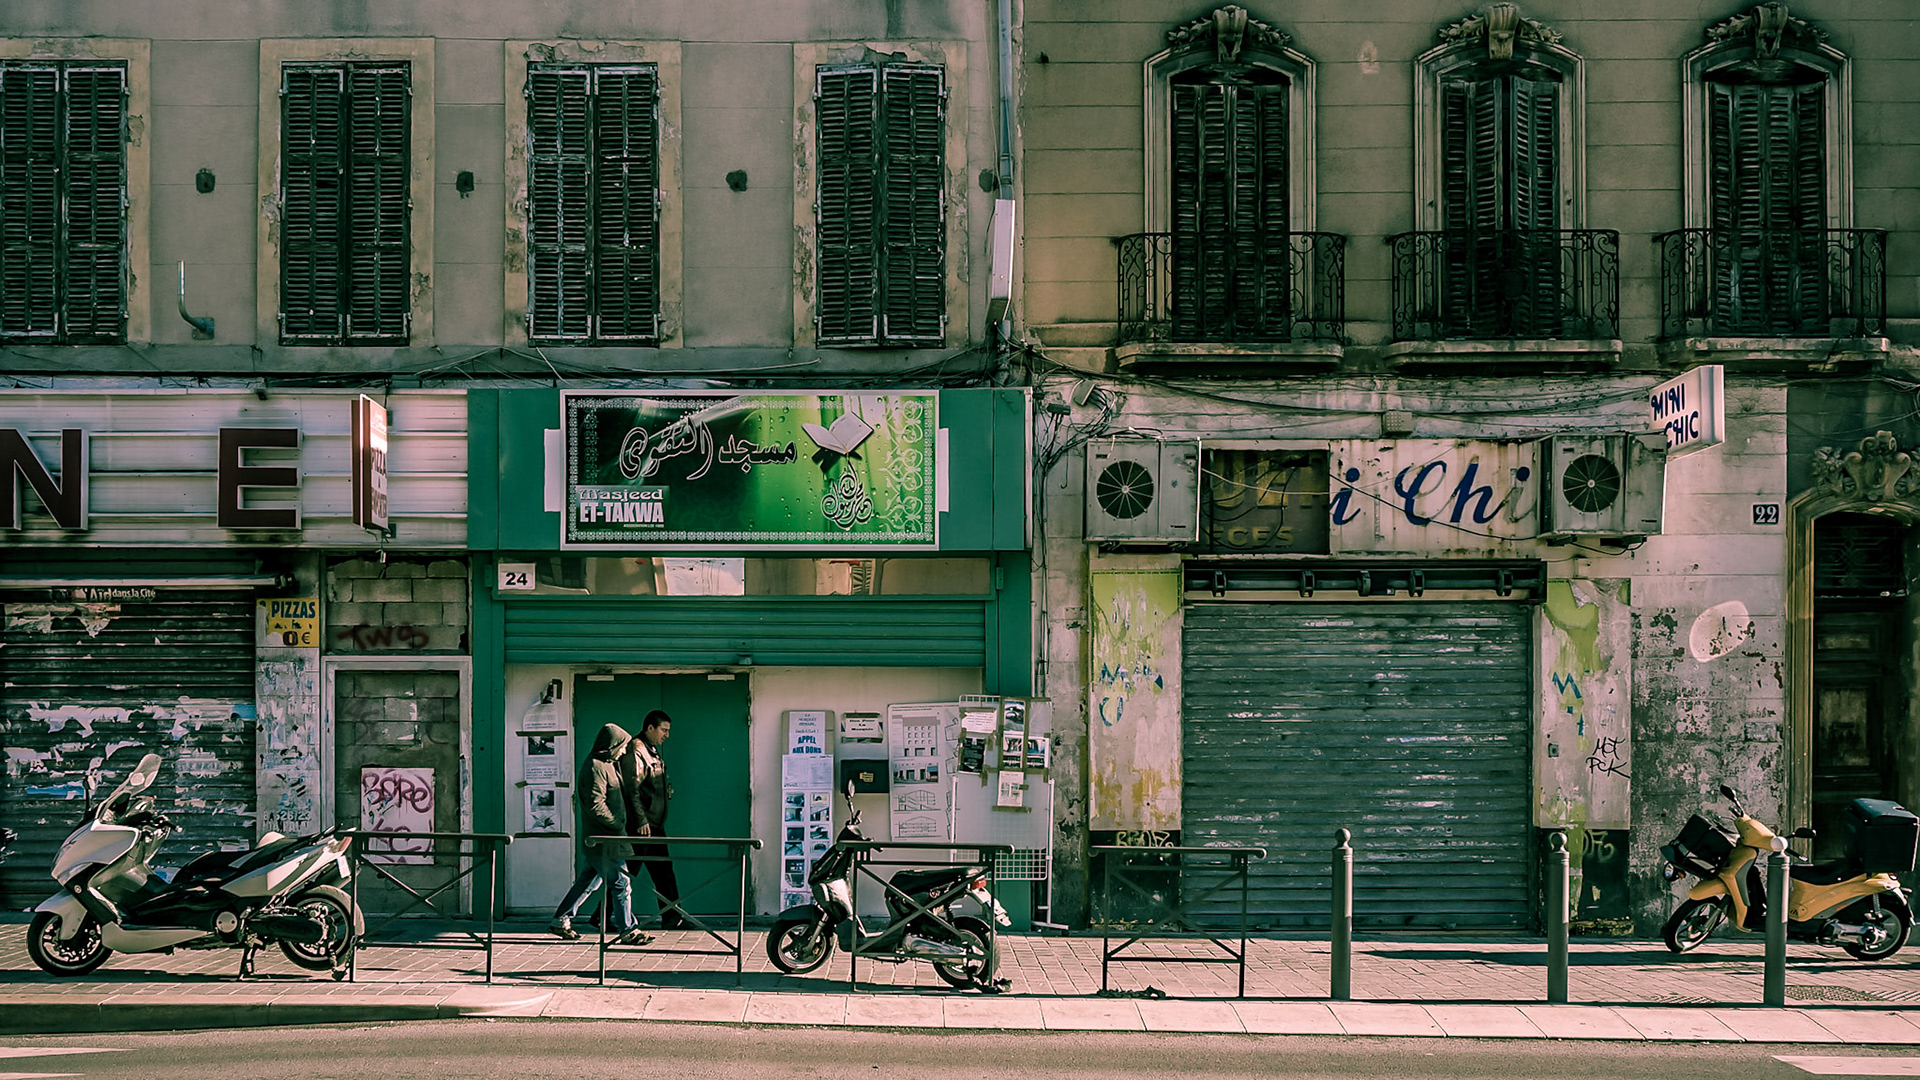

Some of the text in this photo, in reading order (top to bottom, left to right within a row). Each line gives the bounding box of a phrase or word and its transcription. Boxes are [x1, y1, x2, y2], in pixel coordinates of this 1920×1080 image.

[1651, 382, 1685, 421] MINI
[717, 434, 798, 473] مسجد
[580, 489, 664, 502] Masjeed
[579, 501, 664, 523] ET-TAKWA
[1755, 505, 1777, 523] 22
[505, 571, 528, 586] 24
[271, 600, 316, 619] PIZZAS
[798, 735, 817, 745] APPEL
[792, 746, 822, 754] AUX DONS
